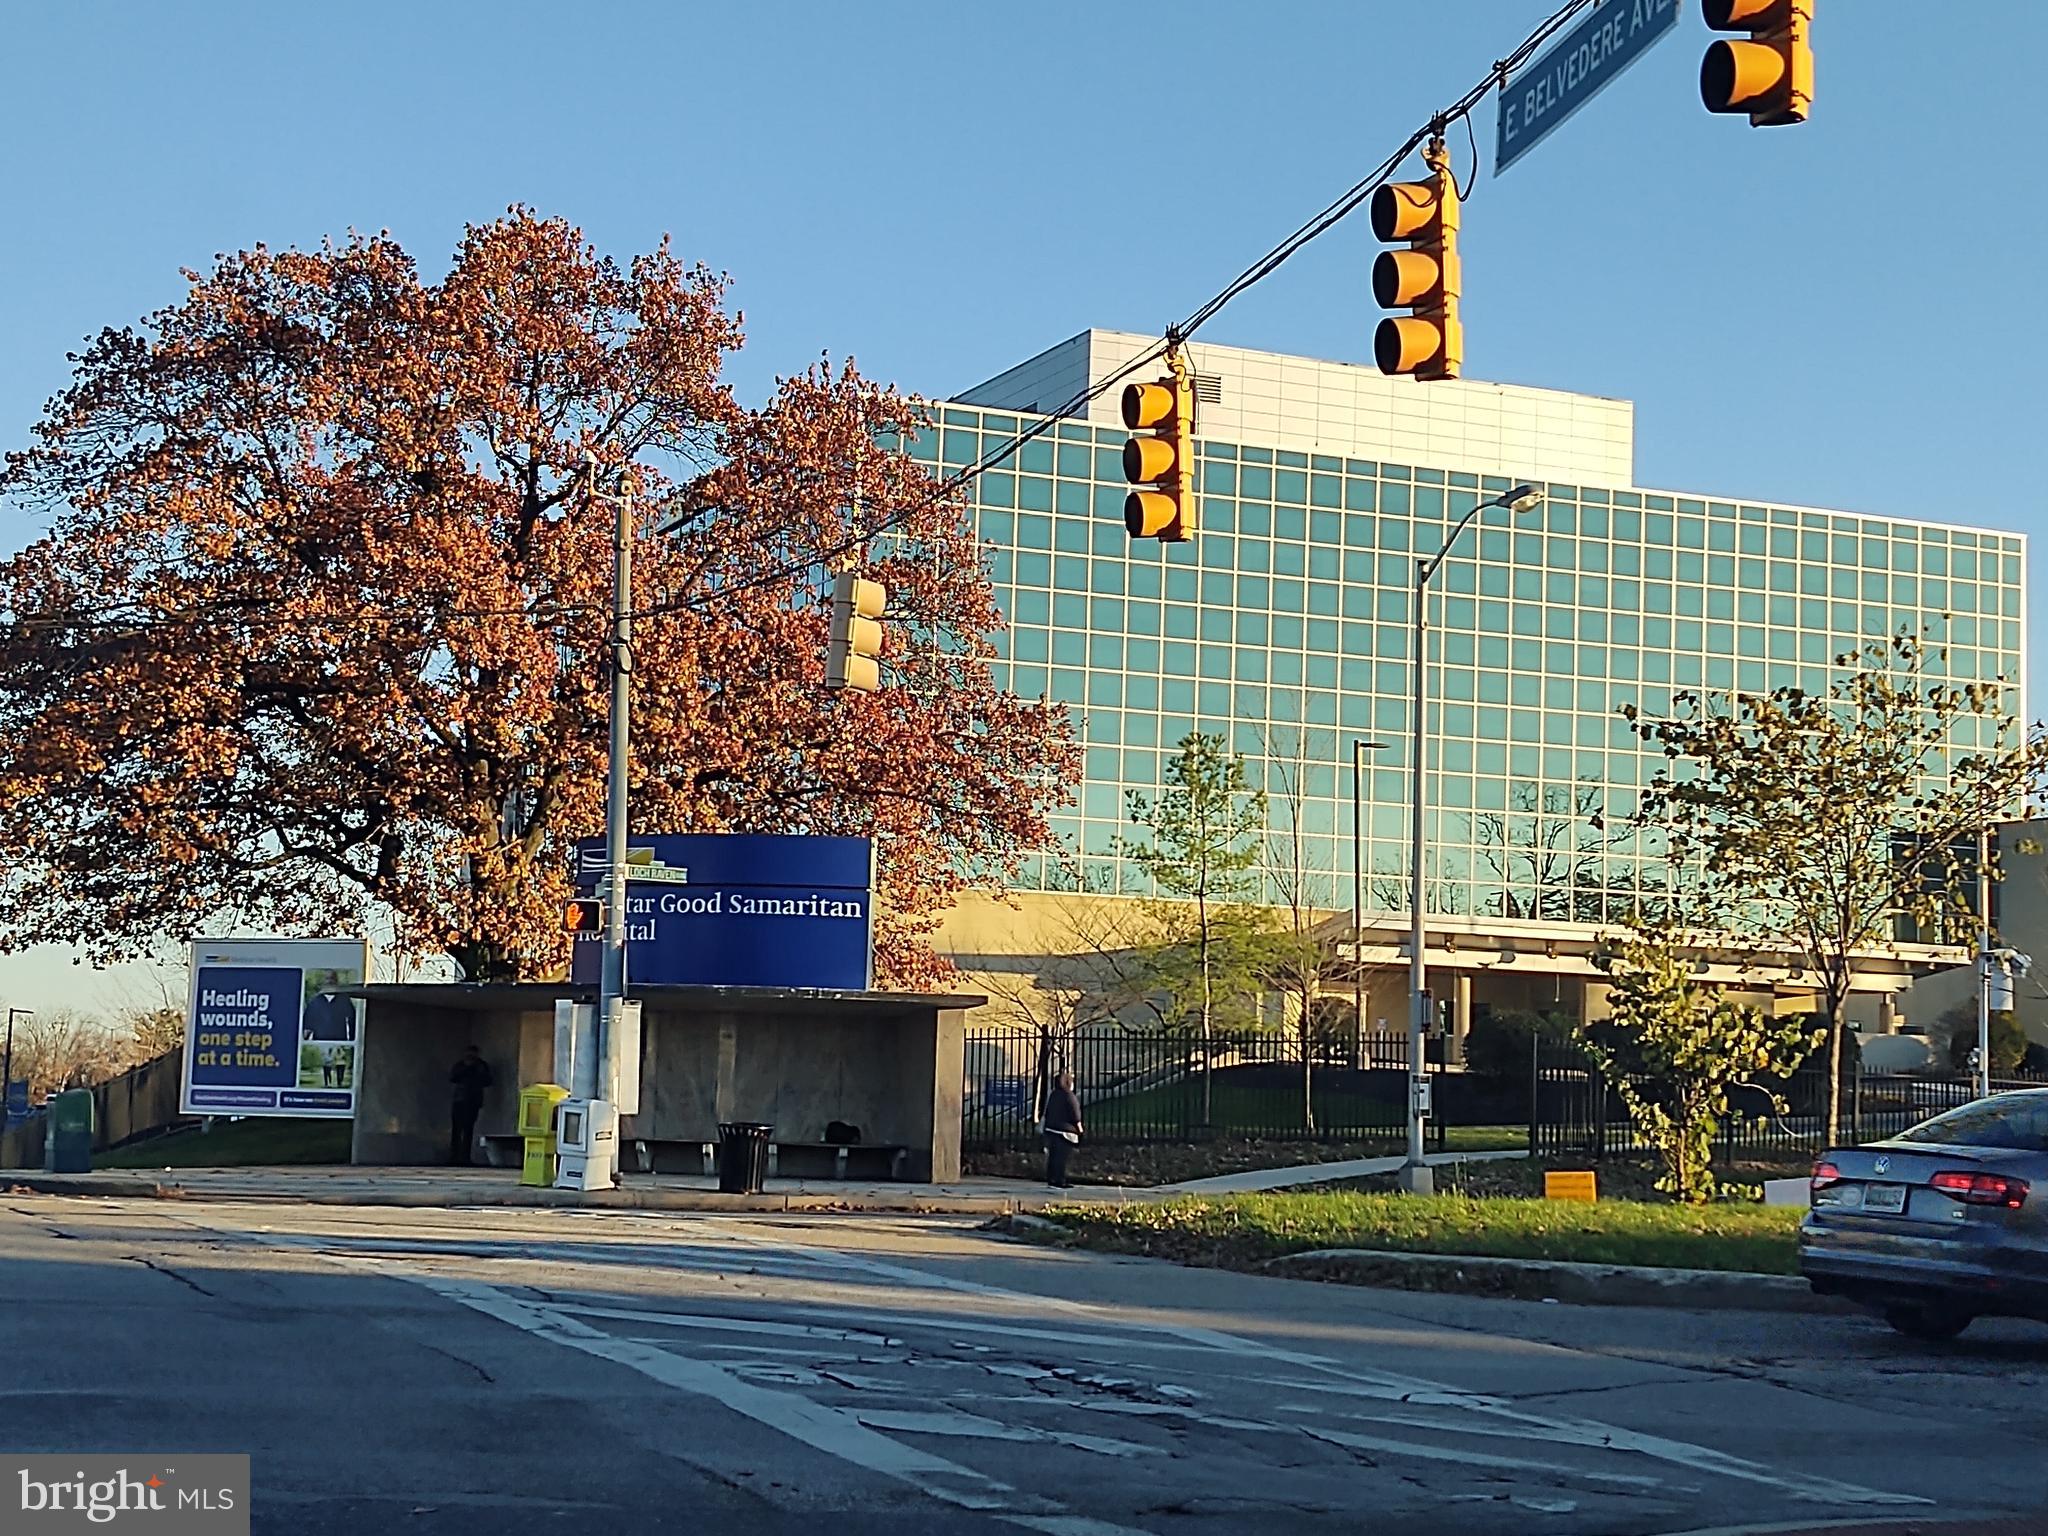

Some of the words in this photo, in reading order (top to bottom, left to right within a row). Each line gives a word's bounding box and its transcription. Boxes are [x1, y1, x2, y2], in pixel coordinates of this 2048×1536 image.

[1524, 10, 1624, 127] BELVEDERE
[660, 892, 722, 914] Good
[729, 894, 862, 918] Samaritan
[202, 989, 270, 1011] Healing
[200, 1010, 273, 1030] wounds,
[200, 1033, 231, 1046] one
[235, 1031, 273, 1051] step
[198, 1050, 216, 1066] at
[220, 1053, 232, 1066] a
[236, 1049, 280, 1067] time.
